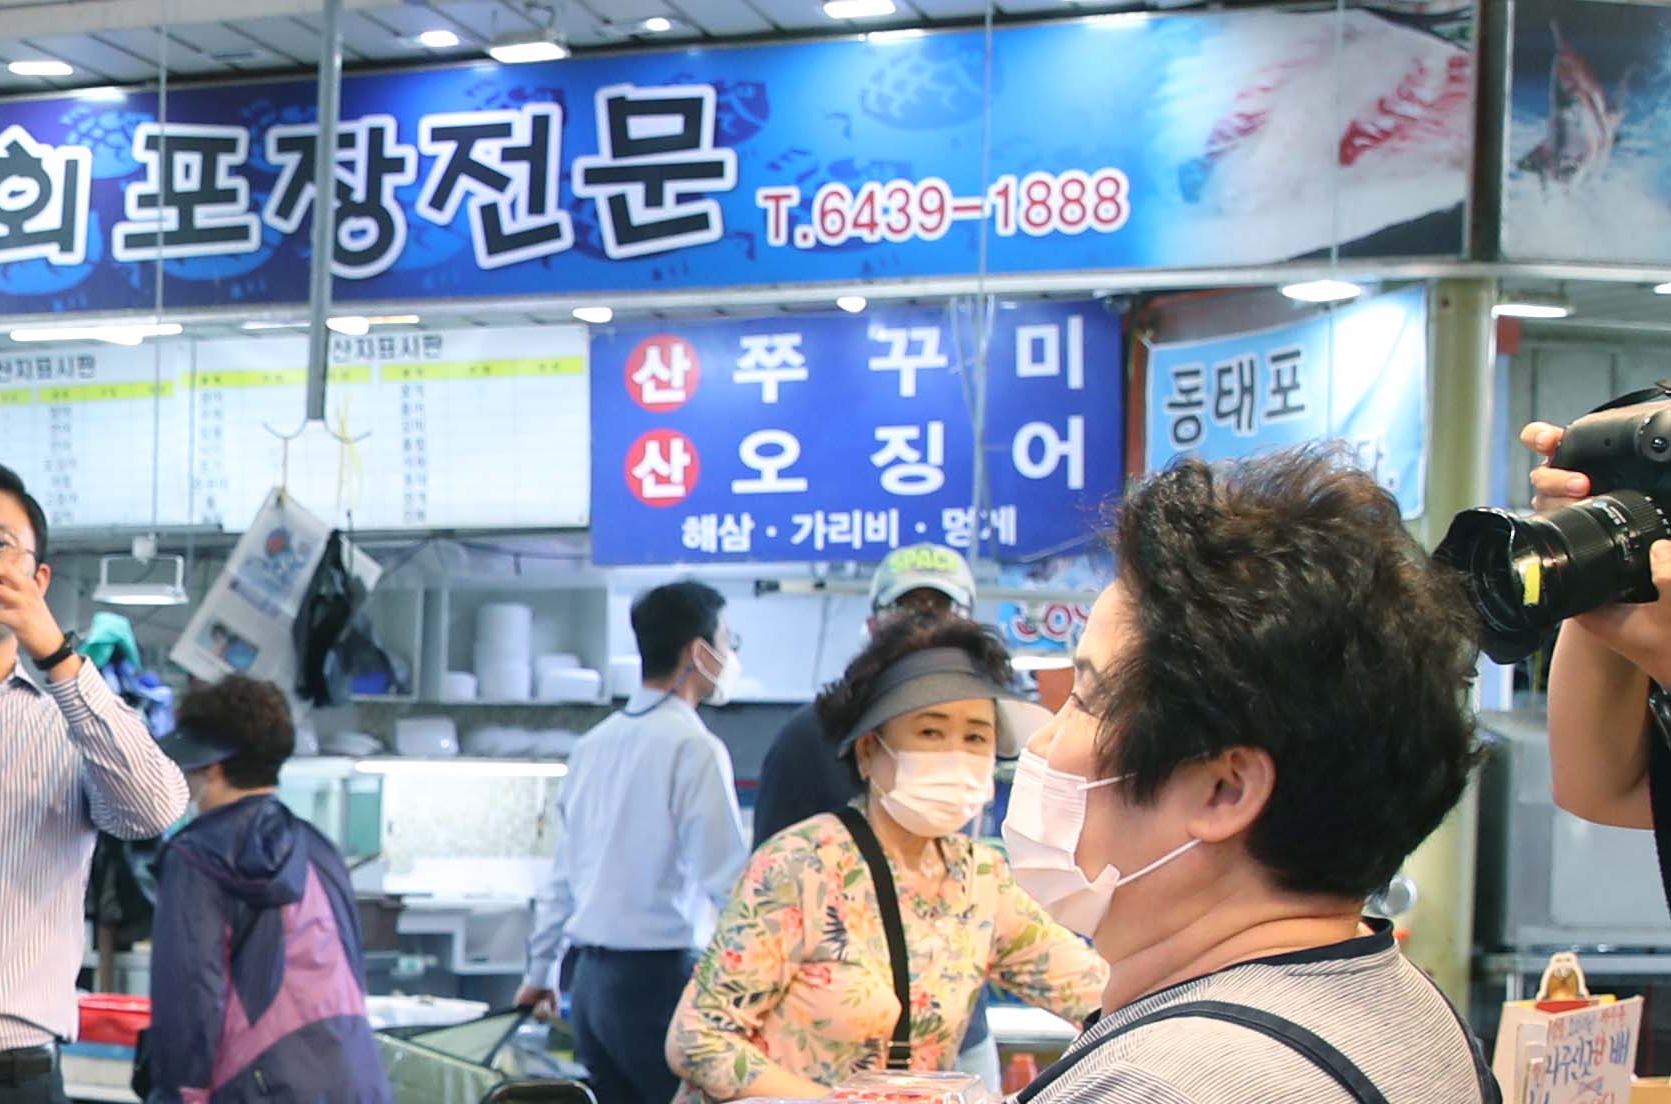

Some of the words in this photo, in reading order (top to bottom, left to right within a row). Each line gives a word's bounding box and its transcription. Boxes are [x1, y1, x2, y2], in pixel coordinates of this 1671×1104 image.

[113, 86, 737, 278] 포장전문
[756, 168, 1129, 247] T.6439-1888
[632, 345, 691, 406] 산
[1163, 346, 1308, 450] 동태포
[632, 439, 691, 500] 산
[731, 415, 1084, 497] 오징어
[682, 514, 753, 553] 해삼
[791, 510, 898, 550] 가리비
